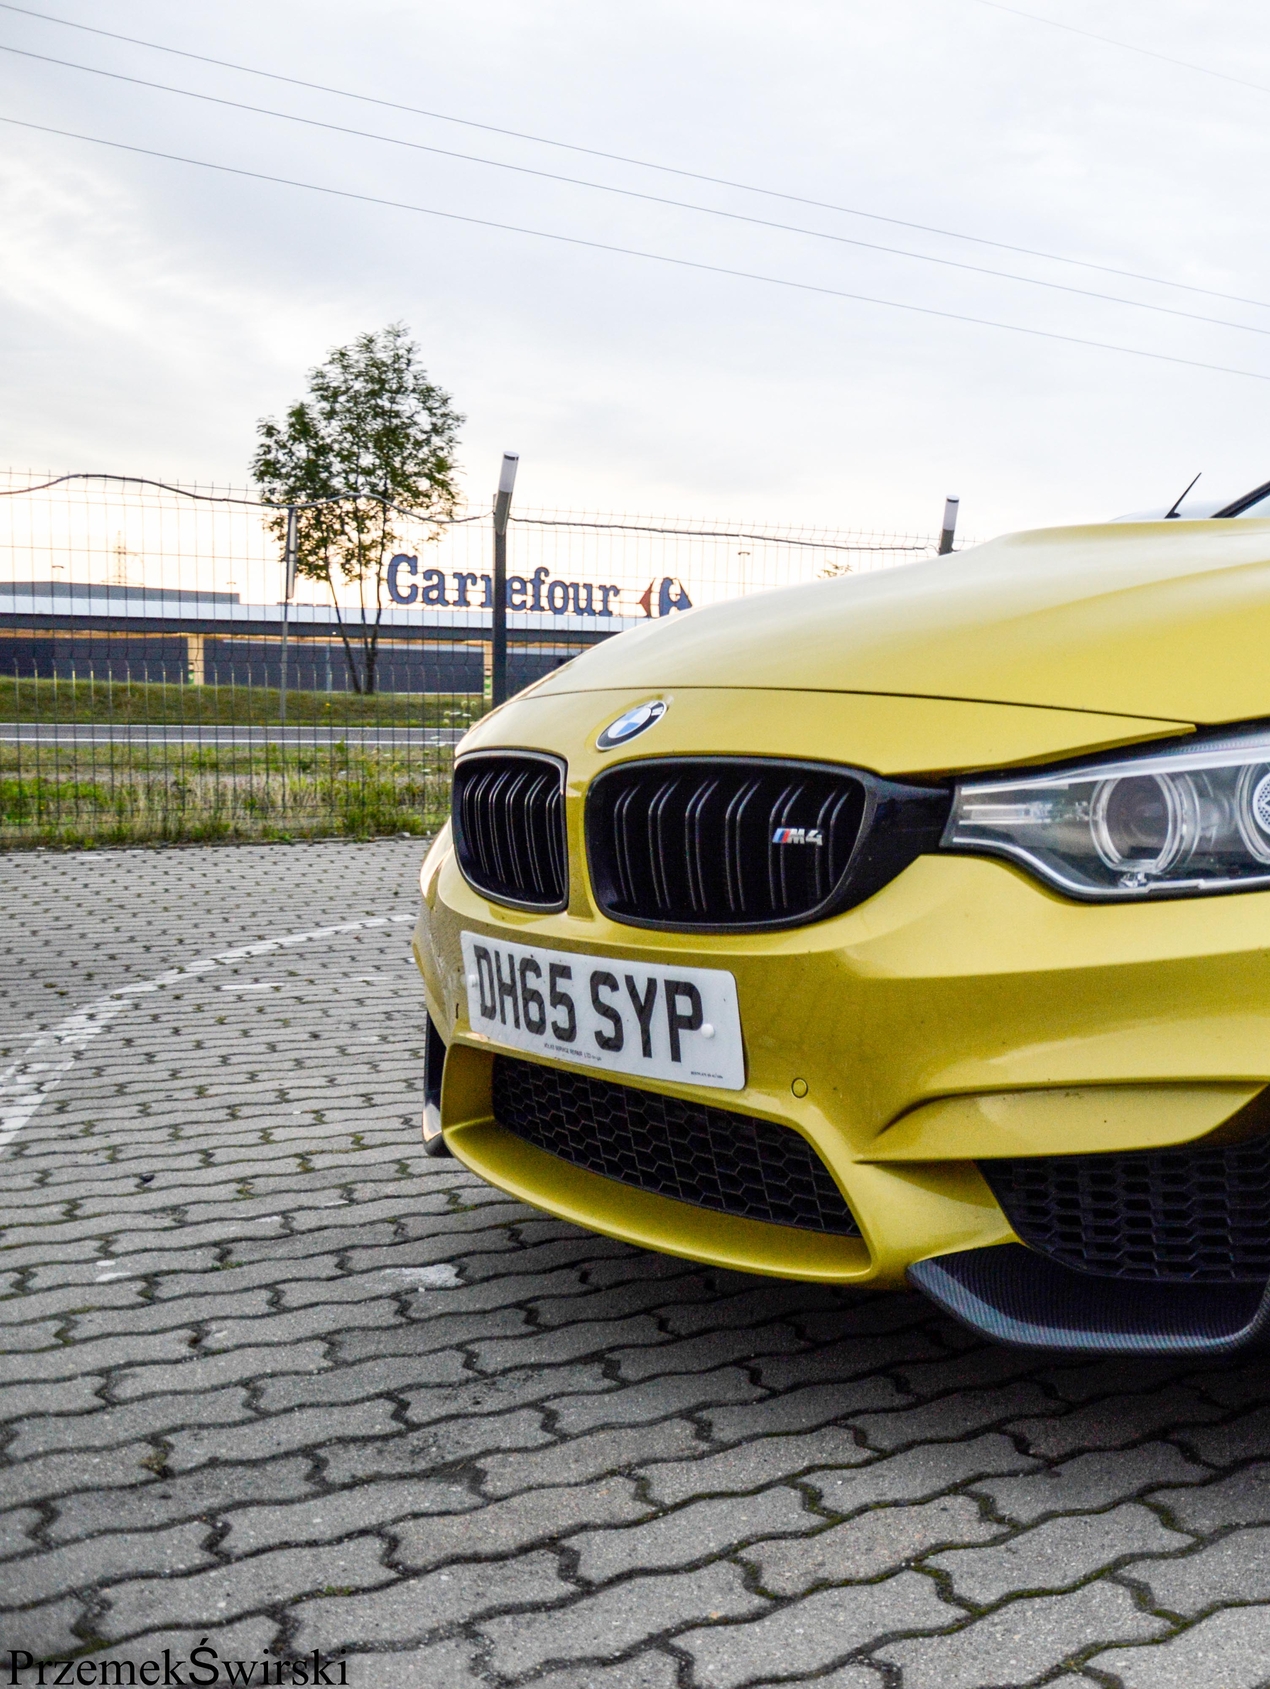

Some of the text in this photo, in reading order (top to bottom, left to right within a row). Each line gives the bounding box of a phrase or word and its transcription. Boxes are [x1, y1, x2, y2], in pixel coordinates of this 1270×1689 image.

[387, 553, 620, 617] Carrefour
[473, 944, 704, 1063] DH65 SYP
